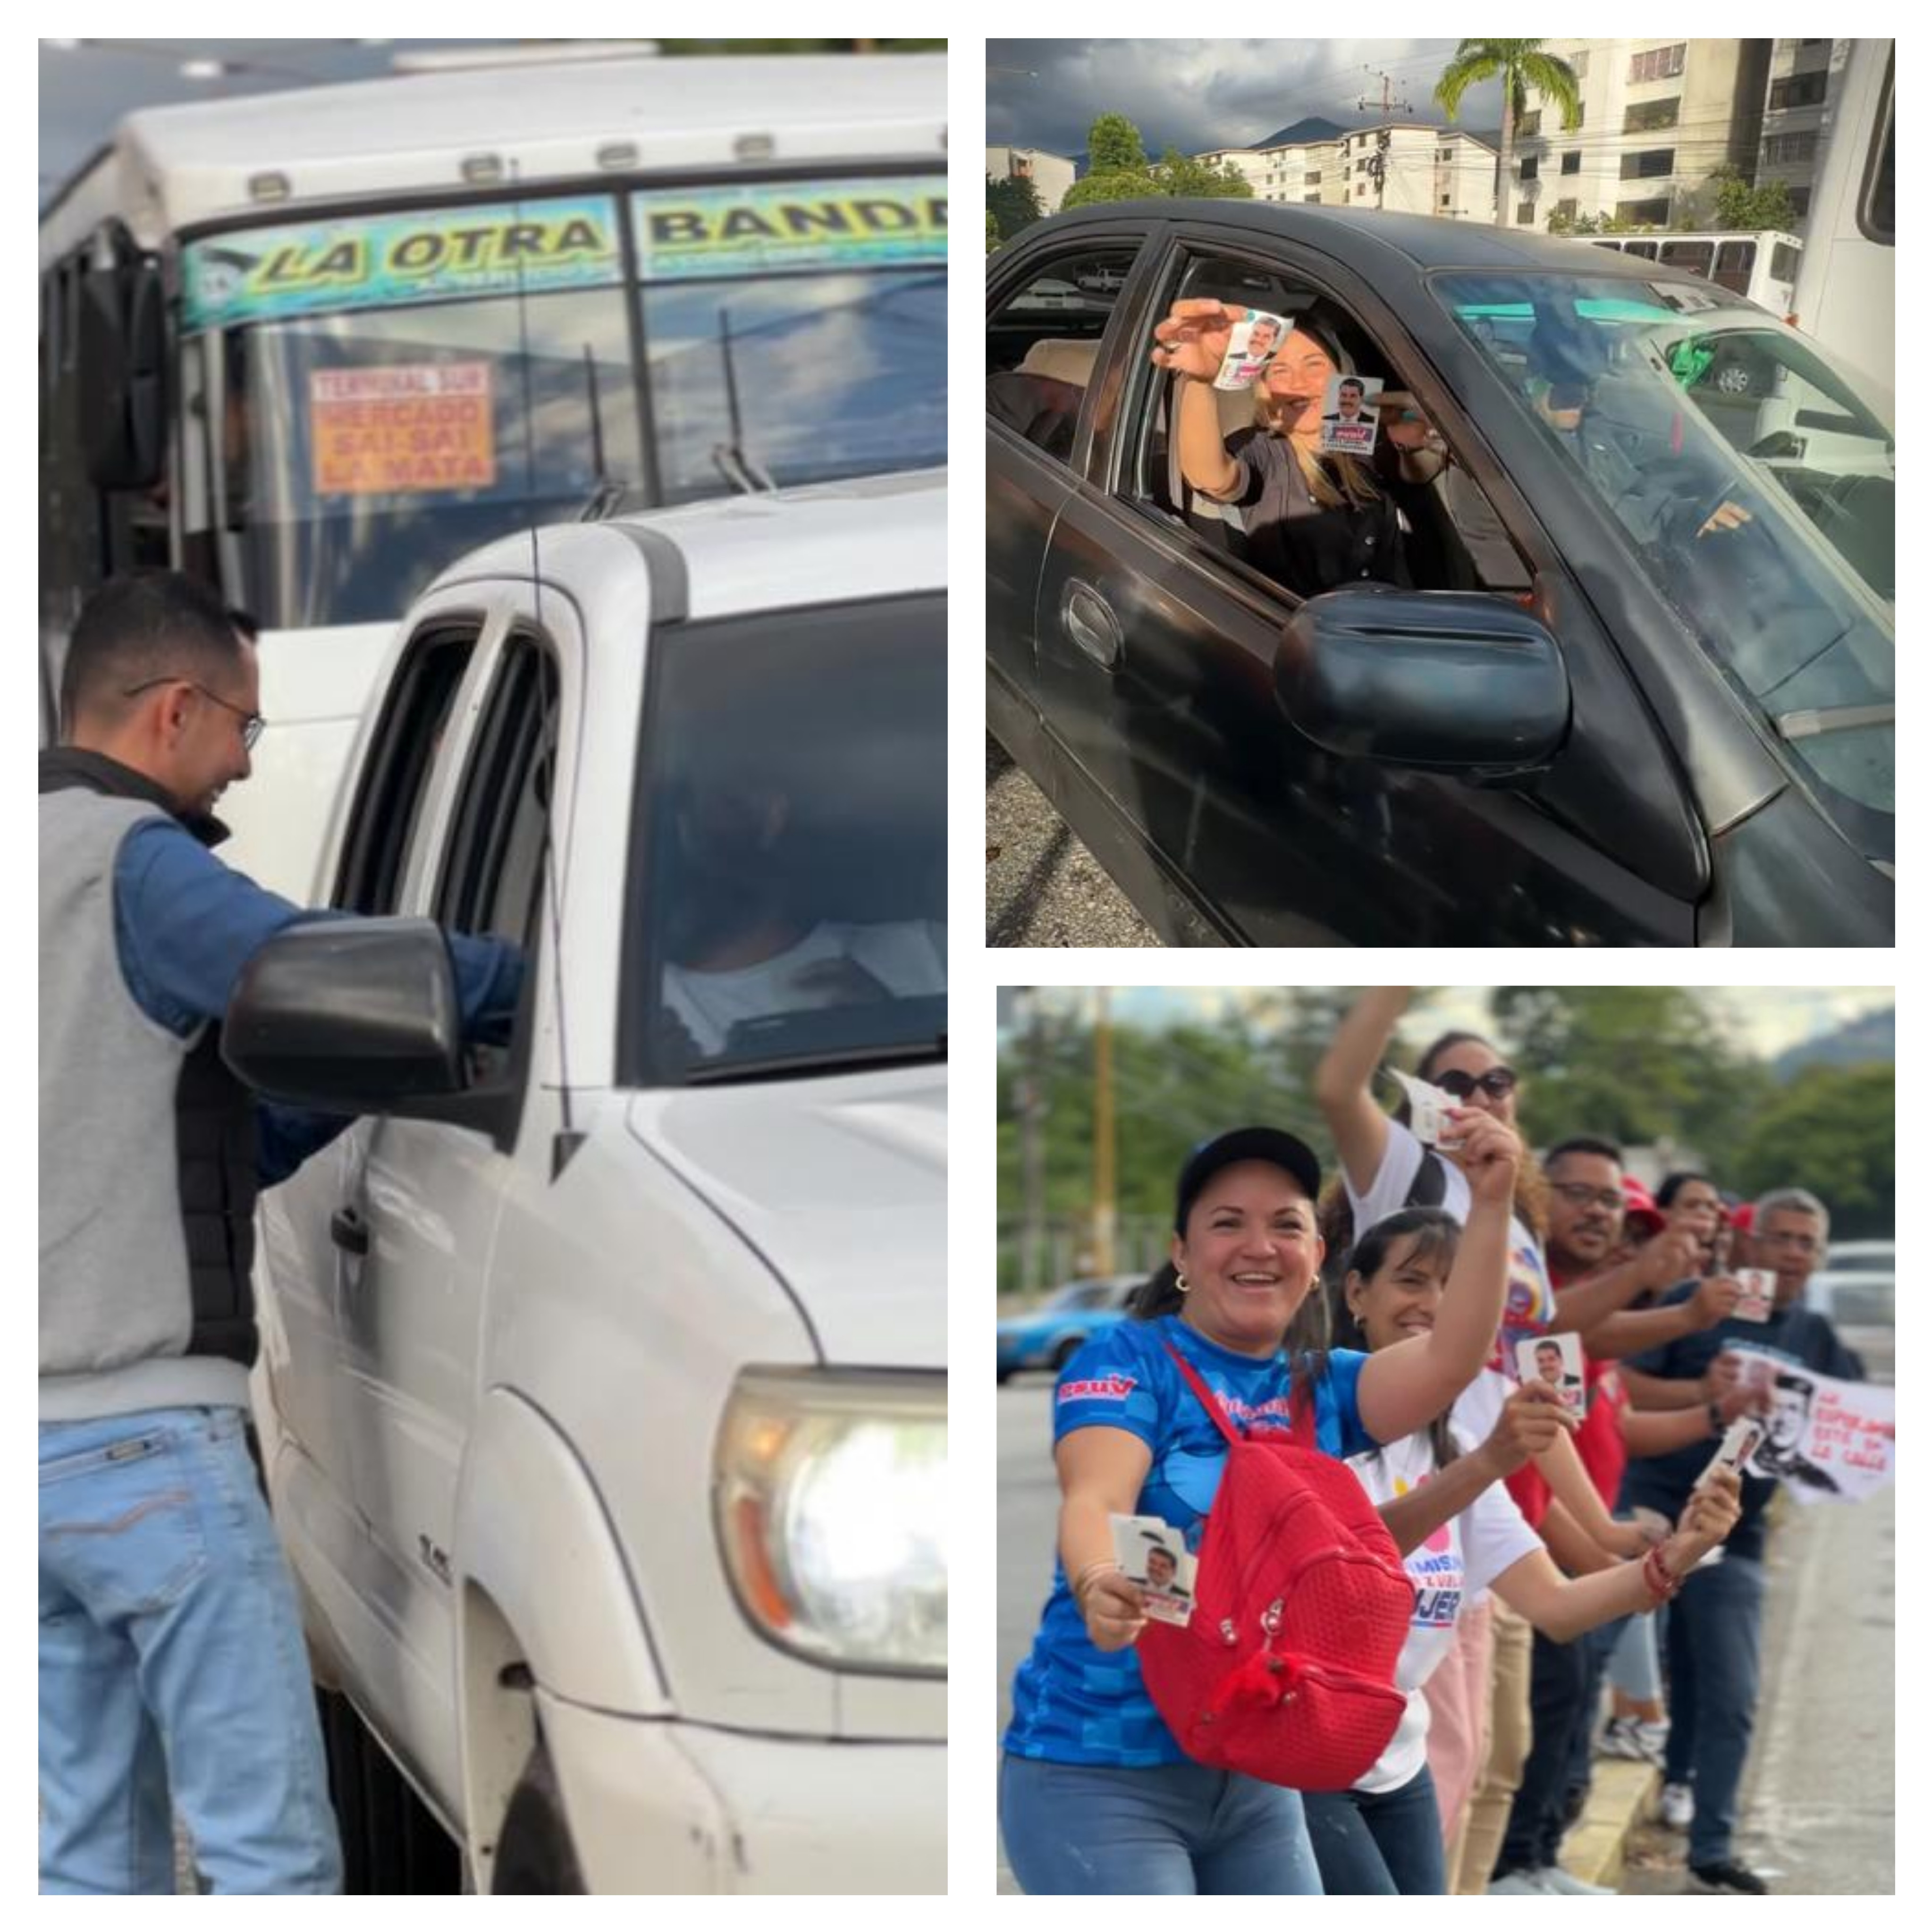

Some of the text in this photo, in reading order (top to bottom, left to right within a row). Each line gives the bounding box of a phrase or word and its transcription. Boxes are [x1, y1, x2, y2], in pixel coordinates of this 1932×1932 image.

[260, 239, 361, 284] LA
[391, 219, 602, 270] OTRA
[384, 456, 483, 479] MATA
